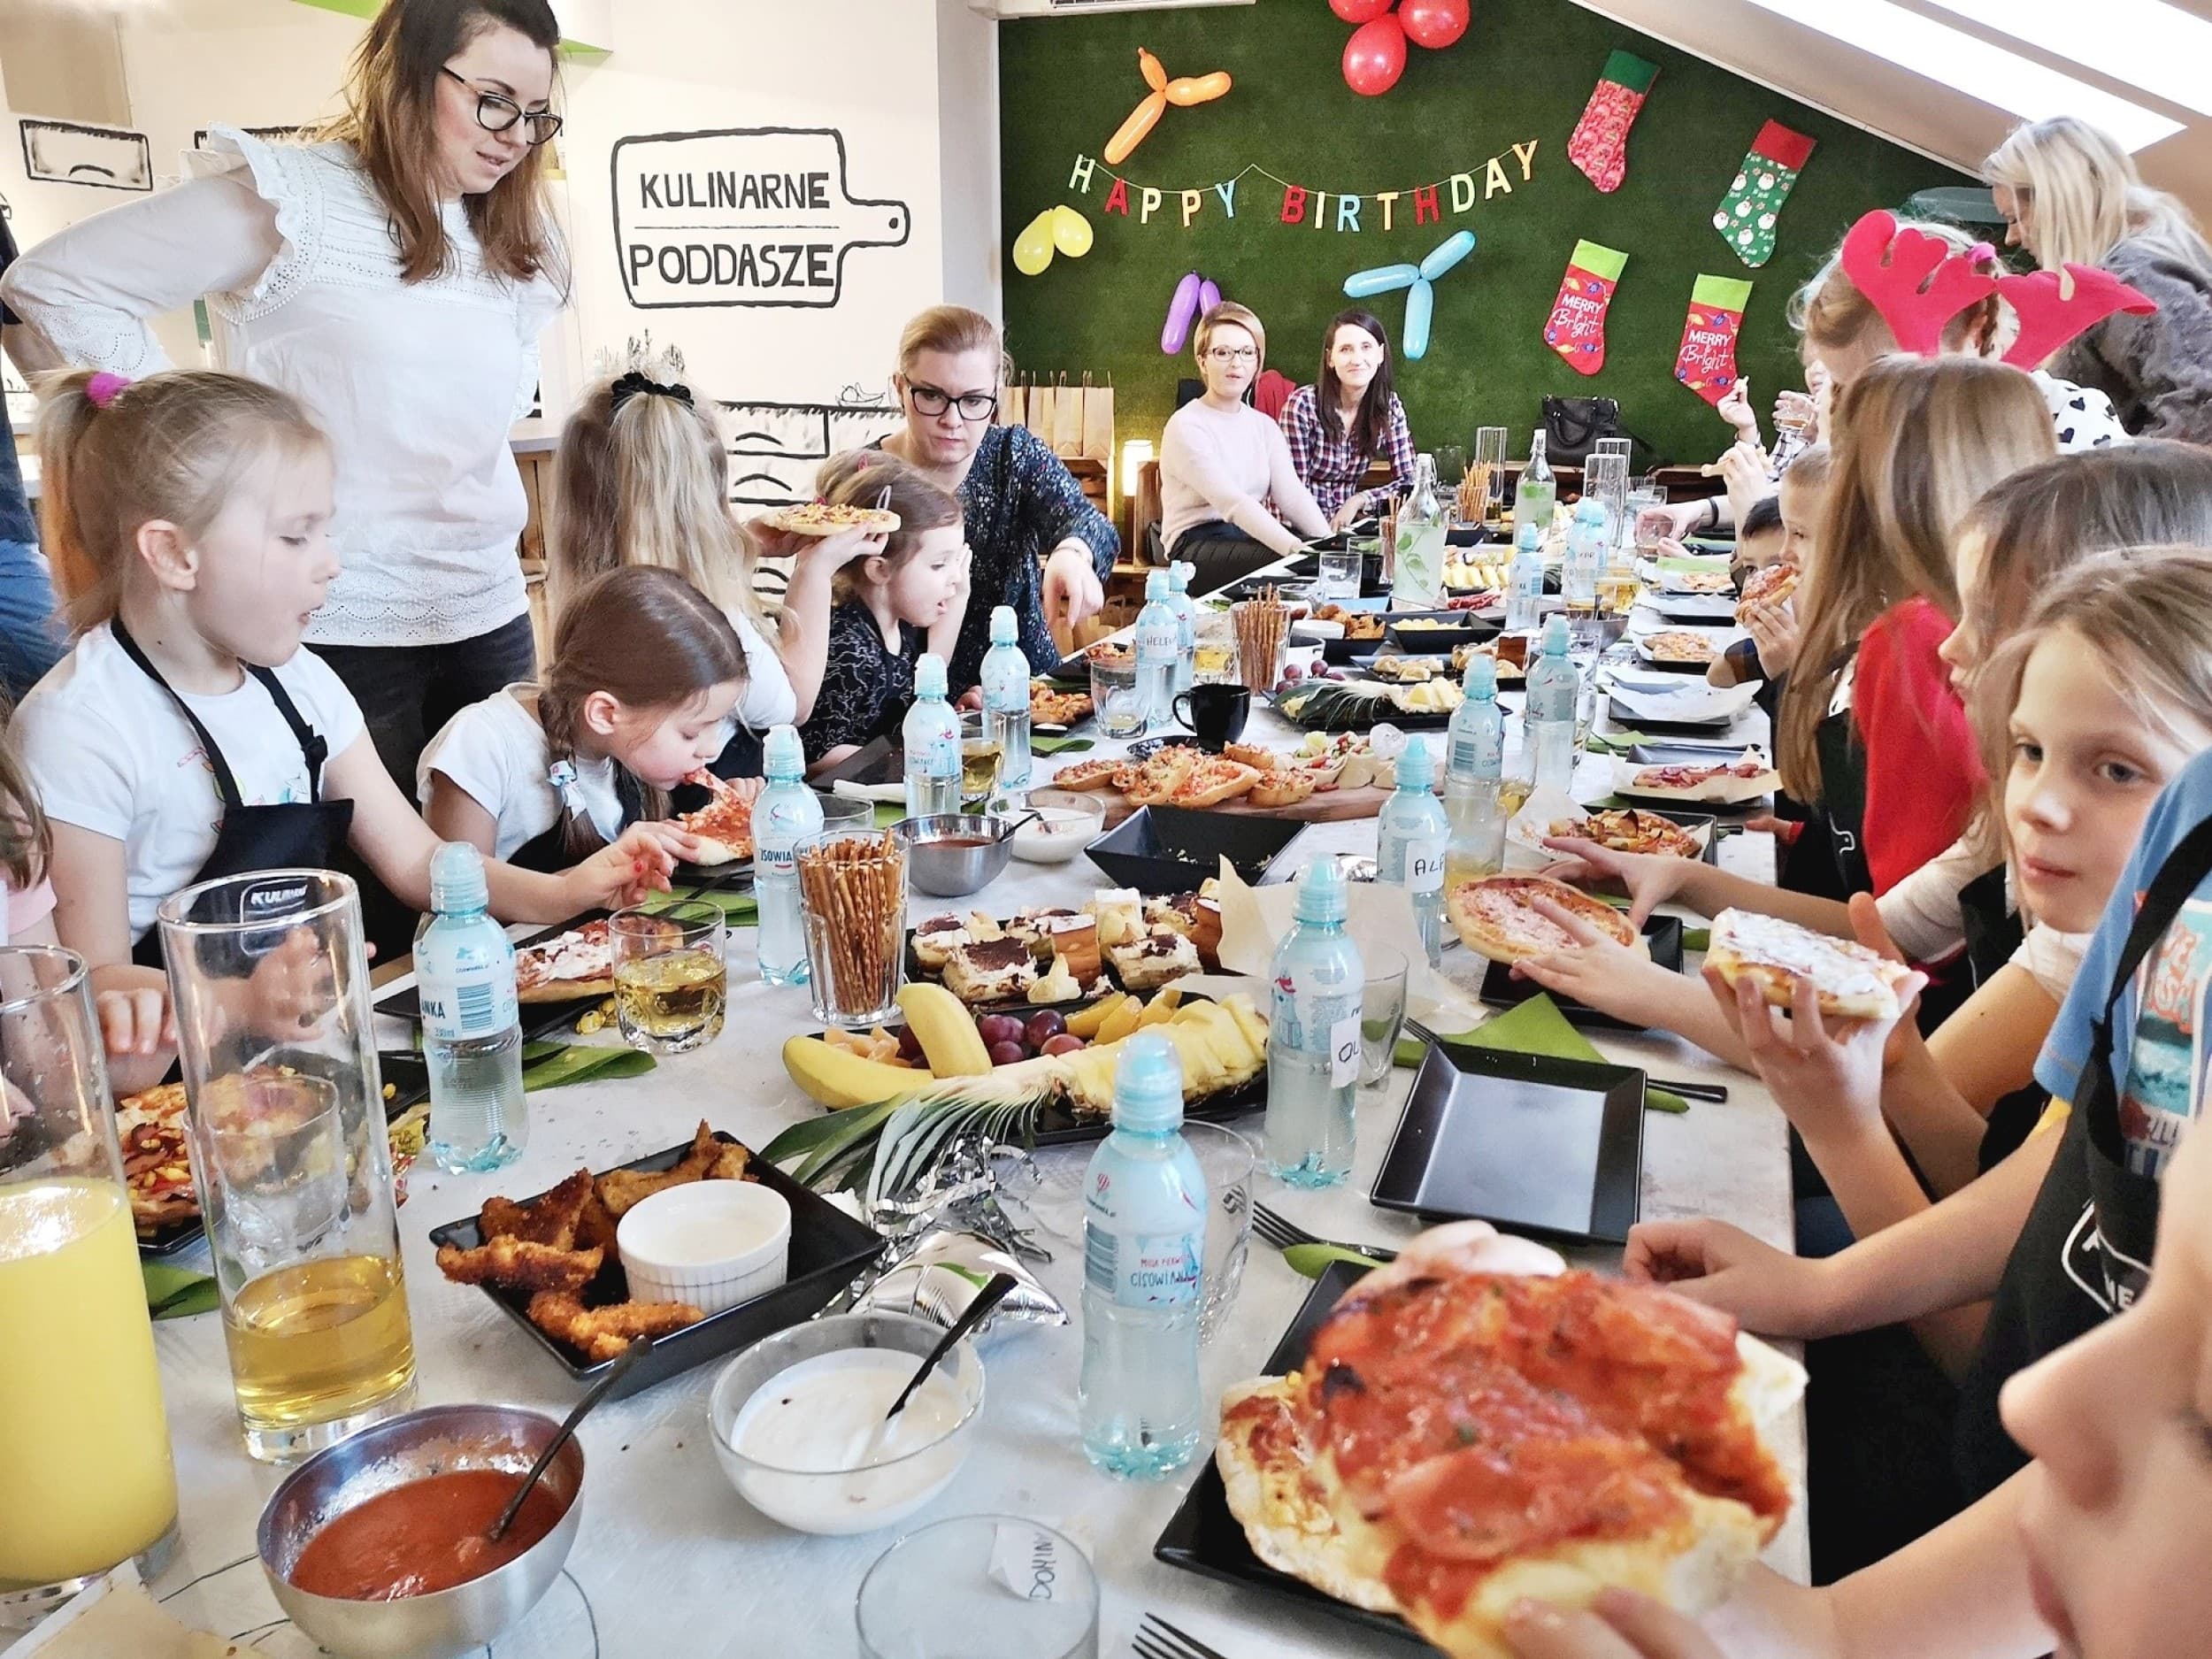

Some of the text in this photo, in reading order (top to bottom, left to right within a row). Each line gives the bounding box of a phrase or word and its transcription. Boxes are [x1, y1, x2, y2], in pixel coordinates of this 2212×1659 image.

[640, 171, 830, 209] KULINARNE
[1068, 140, 1539, 233] HAPPY BIRTHDAY
[629, 243, 834, 288] PODDASZE
[1562, 294, 1604, 314] MERRY
[1551, 307, 1600, 339] Bright
[1688, 329, 1733, 348] MERRY
[1679, 343, 1729, 374] Bright
[759, 848, 795, 862] ISOWIA
